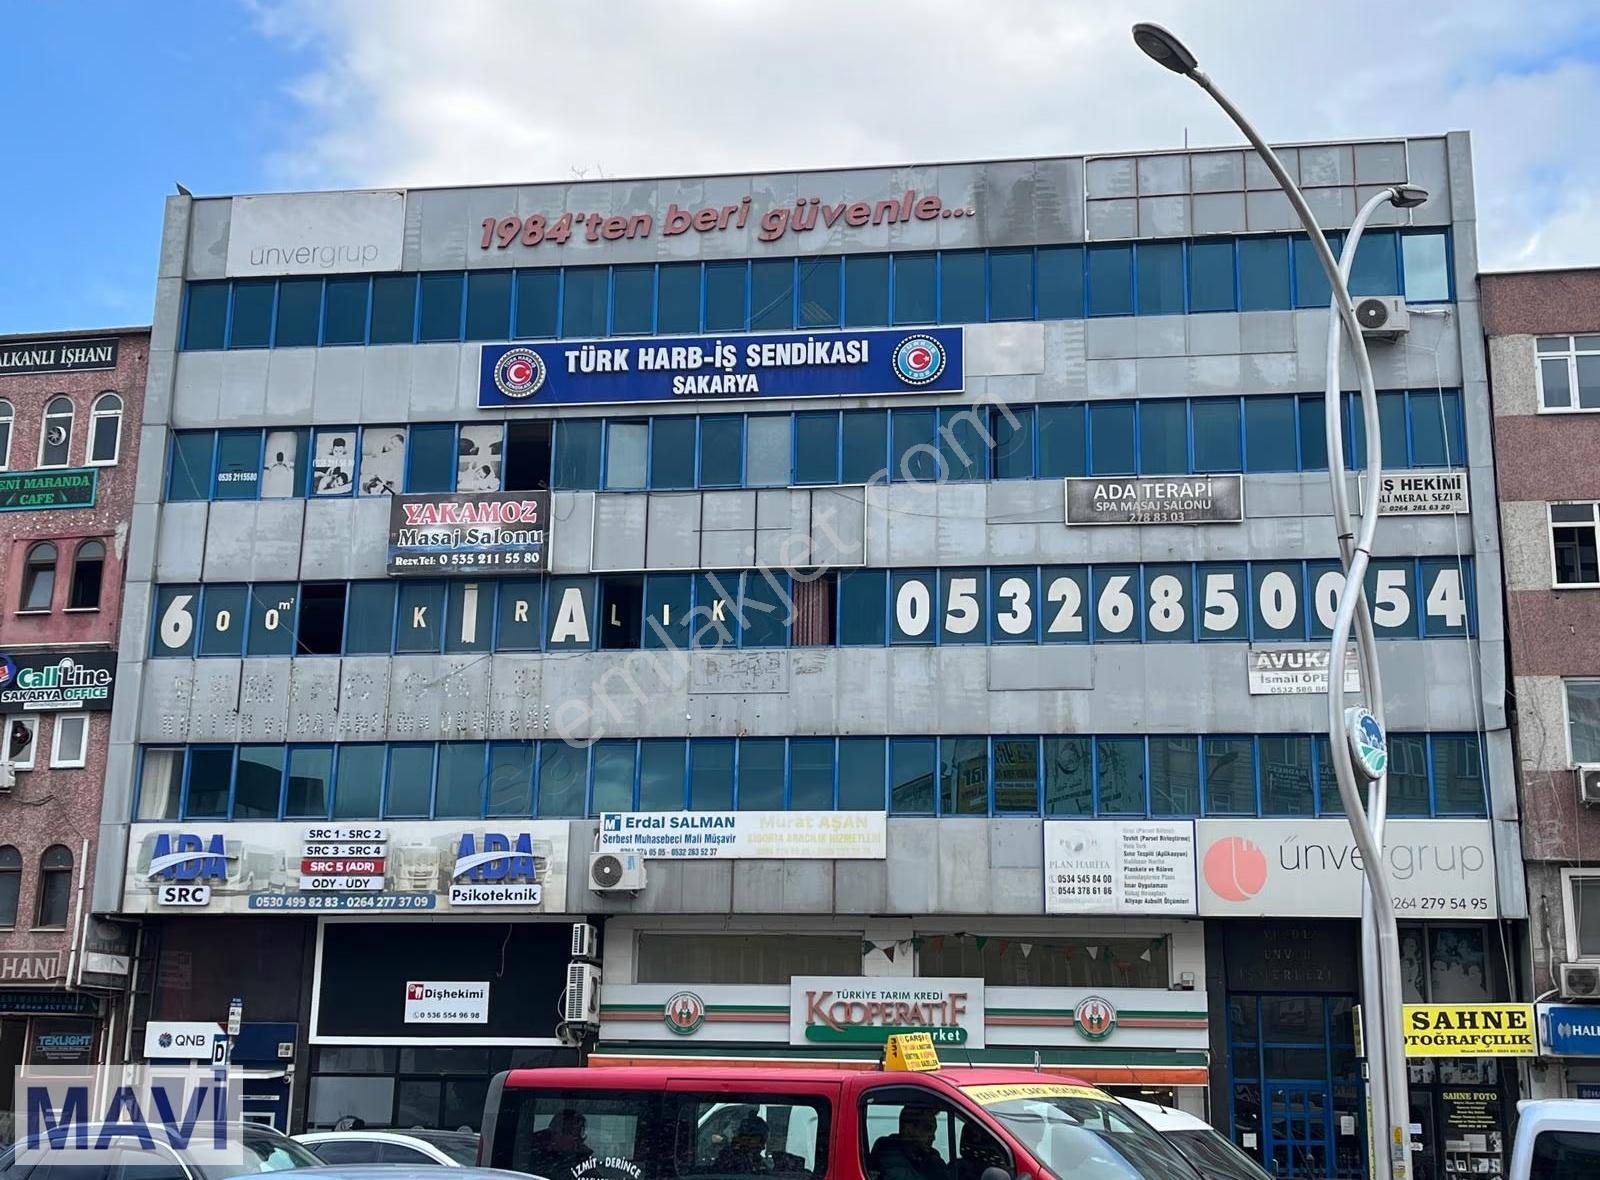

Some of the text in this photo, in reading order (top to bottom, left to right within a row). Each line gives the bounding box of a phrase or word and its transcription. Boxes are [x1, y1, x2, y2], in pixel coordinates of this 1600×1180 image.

[663, 196, 752, 236] beri
[0, 345, 113, 367] LKANLI İŞHANI
[565, 336, 869, 373] TÜRK HARB-İŞ SENDİKASI
[672, 373, 759, 395] SAKARYA
[24, 475, 91, 489] MARANDA
[1094, 478, 1212, 499] ADA TERAPİ
[1401, 475, 1461, 490] HEKİMİ
[20, 493, 55, 504] CAFE
[1394, 493, 1429, 503] MERAL
[1096, 500, 1211, 511] SPA MASAJ SALONU
[403, 501, 537, 525] YAKAMOZ
[398, 528, 543, 548] Masaj Salonu
[452, 555, 474, 564] 535
[478, 554, 499, 564] 211
[505, 553, 519, 563] 55
[523, 552, 540, 563] 80
[1256, 652, 1347, 669] AVUKA
[1, 687, 108, 702] SAKARYA OFFICE
[626, 817, 735, 828] Erdal SALMAN
[309, 830, 381, 839] SRC 1 SRC 2
[603, 834, 736, 845] Serbest Muhasebeci Mali Müşavir
[150, 833, 229, 881] ADA
[307, 846, 381, 855] SRC 3 SRC 4
[455, 833, 537, 881] ADA
[1279, 835, 1484, 880] ünvegrup
[310, 861, 375, 872] SRC 5 (ADR)
[312, 879, 370, 888] ODY UDY
[1058, 875, 1075, 884] 0534
[1077, 875, 1090, 883] 545
[165, 888, 203, 902] SRC
[452, 888, 537, 901] Psikoteknik
[1058, 887, 1075, 895] 0544
[256, 897, 428, 907] 0530 499 82 83 0264 277 37 09
[1392, 897, 1488, 909] 264 279 54 95
[0, 957, 57, 979] HANI
[425, 988, 484, 1000] Dişhekimi
[837, 989, 943, 1000] TÜRKİYE TARIM KREDİ
[1412, 1011, 1527, 1030] SAHNE
[175, 1035, 205, 1046] QNB
[1405, 1032, 1531, 1047] TOĞRAFÇILIK
[215, 1044, 224, 1062] D
[1443, 1092, 1497, 1100] SAHNE FOTO
[571, 1156, 641, 1179] İZMİT DERİNCE
